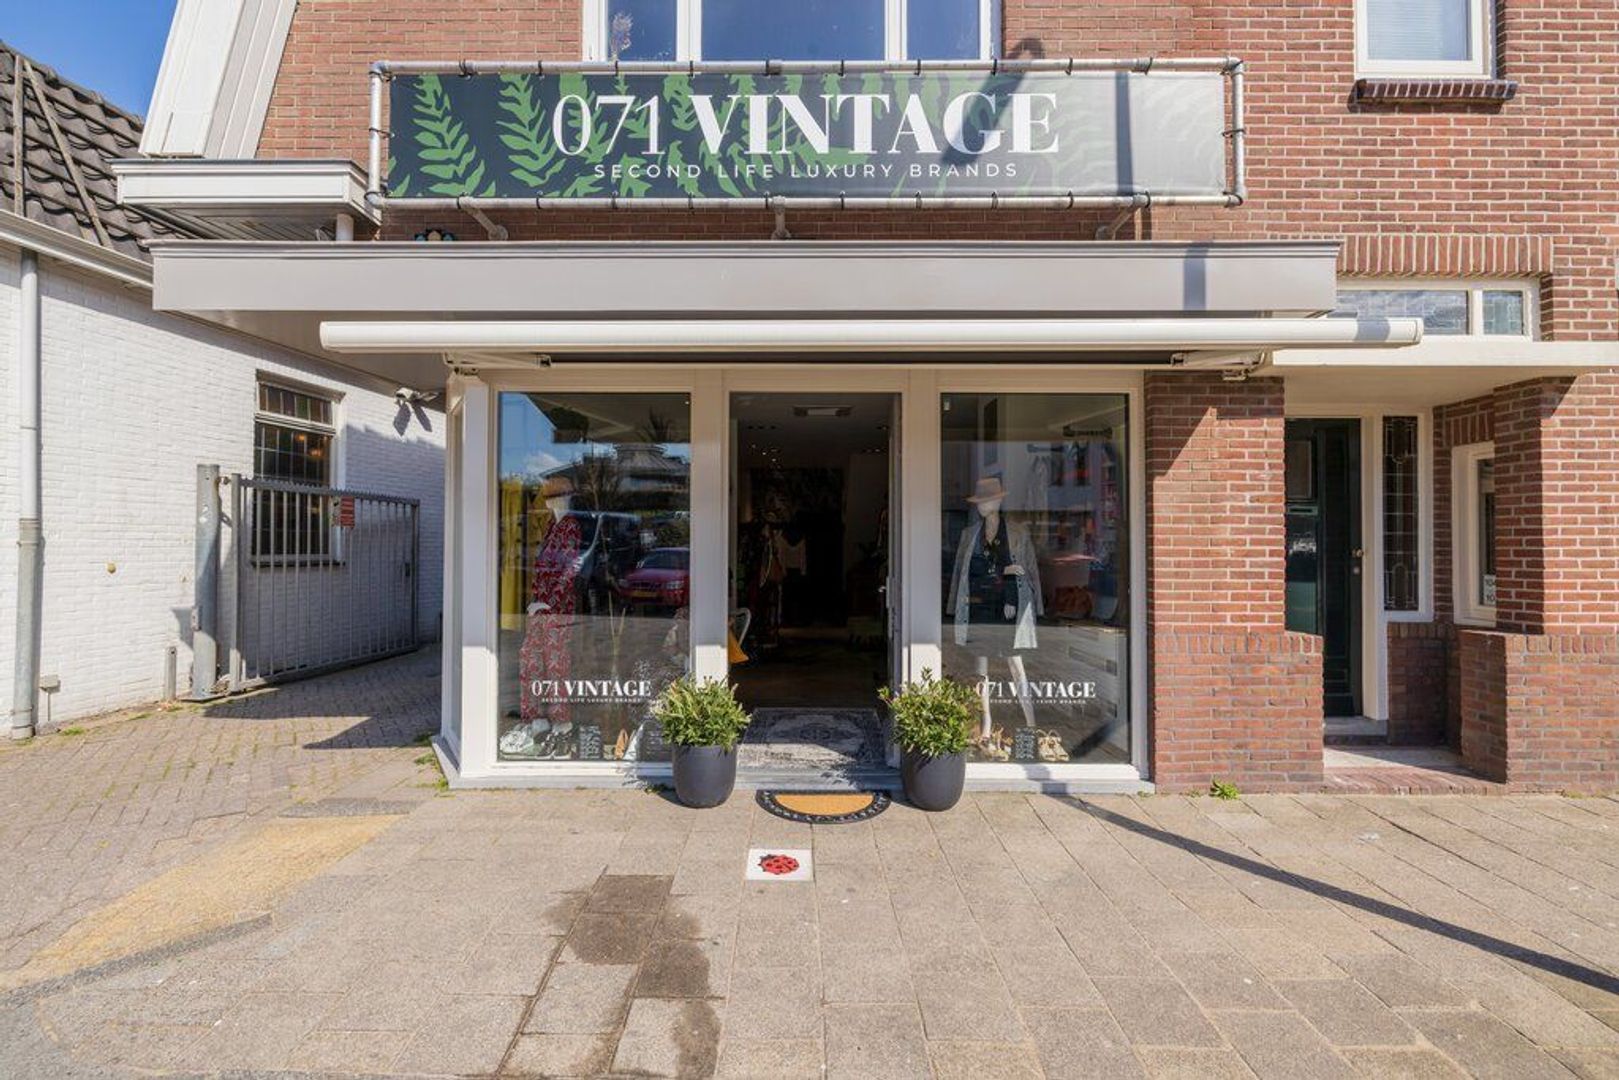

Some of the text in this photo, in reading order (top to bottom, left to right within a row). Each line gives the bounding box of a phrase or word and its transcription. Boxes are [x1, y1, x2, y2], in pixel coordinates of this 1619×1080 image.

[552, 91, 1060, 157] 071 VINTAGE
[593, 162, 1018, 179] SECOND LIFE LUXURY BRANDS
[531, 679, 652, 697] 071 VINTAGE
[1008, 680, 1097, 698] VINTAGE
